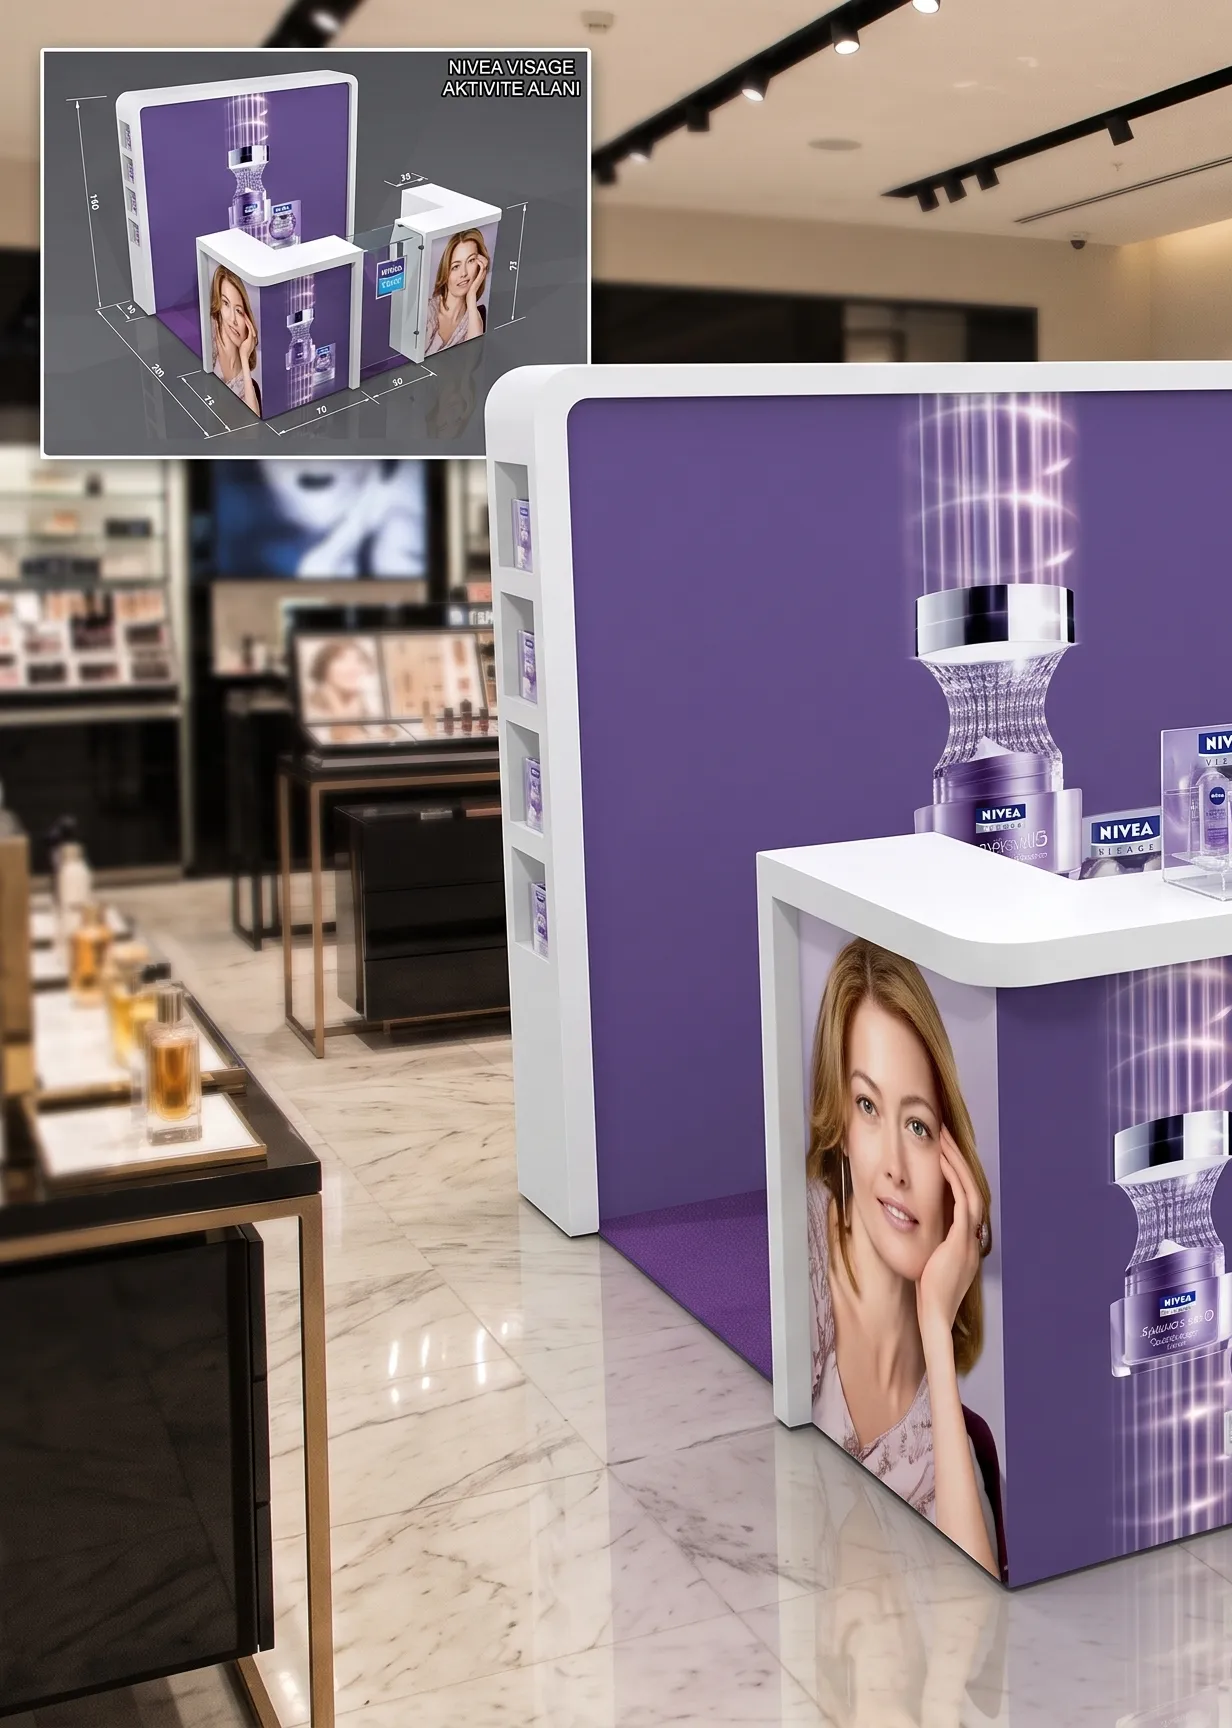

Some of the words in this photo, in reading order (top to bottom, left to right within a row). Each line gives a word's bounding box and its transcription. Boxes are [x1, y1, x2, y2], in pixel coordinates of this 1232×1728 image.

[982, 808, 1021, 821] NIVEA
[1100, 821, 1154, 840] NIVEA
[1164, 1294, 1192, 1307] NIVEA
